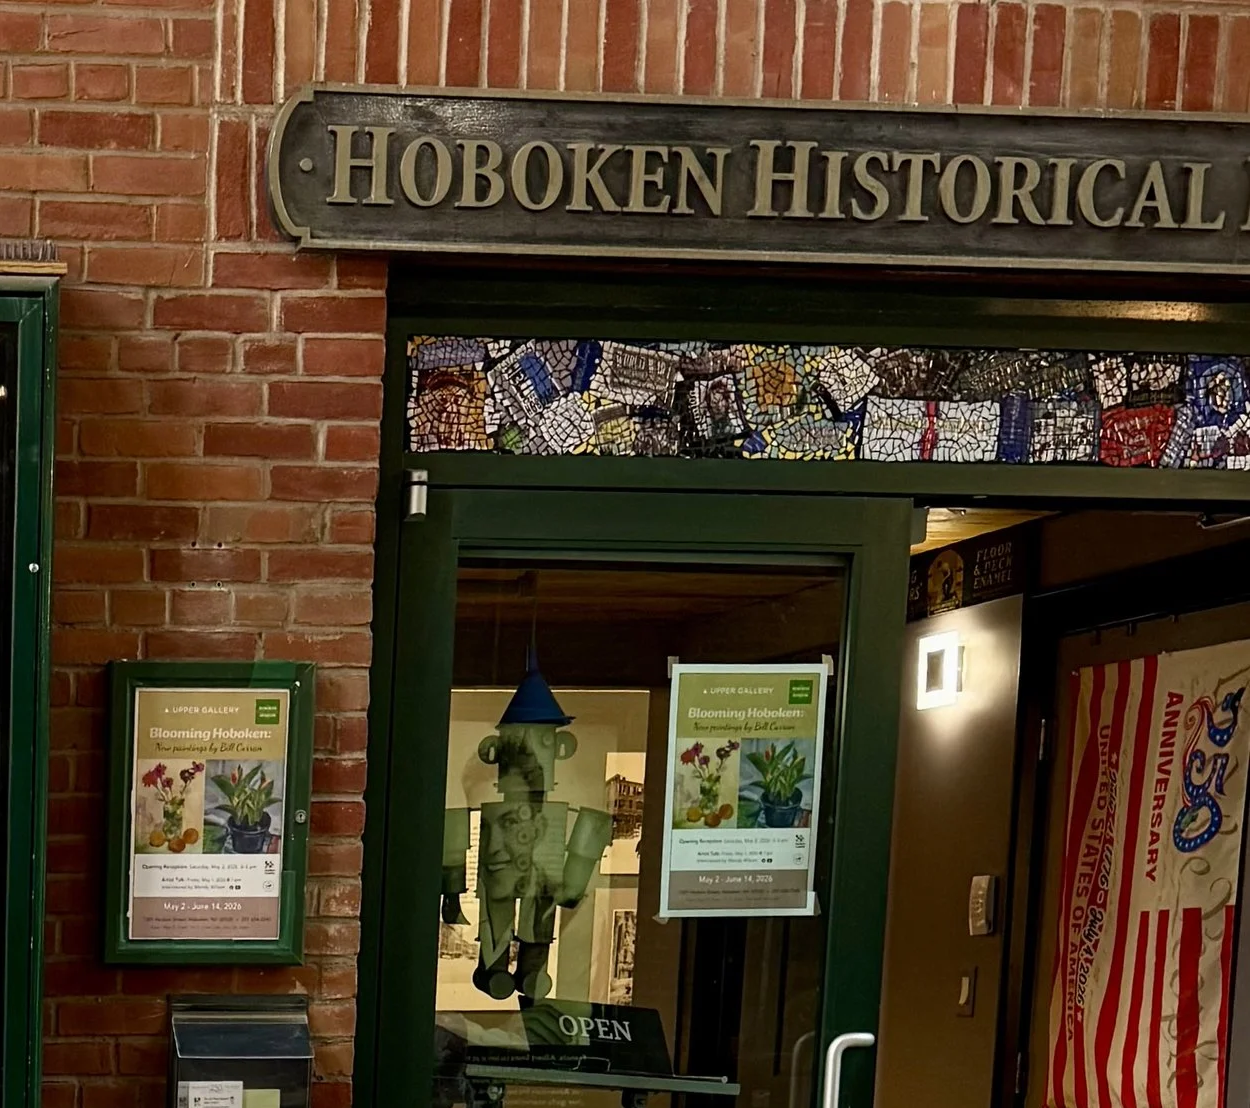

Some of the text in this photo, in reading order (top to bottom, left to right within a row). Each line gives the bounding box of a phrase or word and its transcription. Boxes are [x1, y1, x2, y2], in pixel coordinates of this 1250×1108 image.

[326, 123, 1227, 230] HOBOKEN HISTORICAL
[977, 541, 1012, 563] FLOOR
[973, 570, 1012, 589] ENAMEL
[688, 707, 804, 720] Blooming Hoboken:
[150, 728, 271, 741] Blooming Hoboken:
[173, 743, 207, 754] paintings
[209, 743, 218, 753] by
[220, 742, 235, 752] Bill
[1145, 691, 1184, 882] ANNIVERSARY
[1066, 724, 1111, 1041] UNITED STATES OF AMERICA
[164, 903, 179, 911] May
[192, 902, 209, 910] June
[211, 902, 222, 911] 14,
[223, 902, 241, 910] 2026
[1082, 906, 1103, 943] July
[1076, 959, 1089, 1006] 2026
[559, 1014, 633, 1042] OPEN
